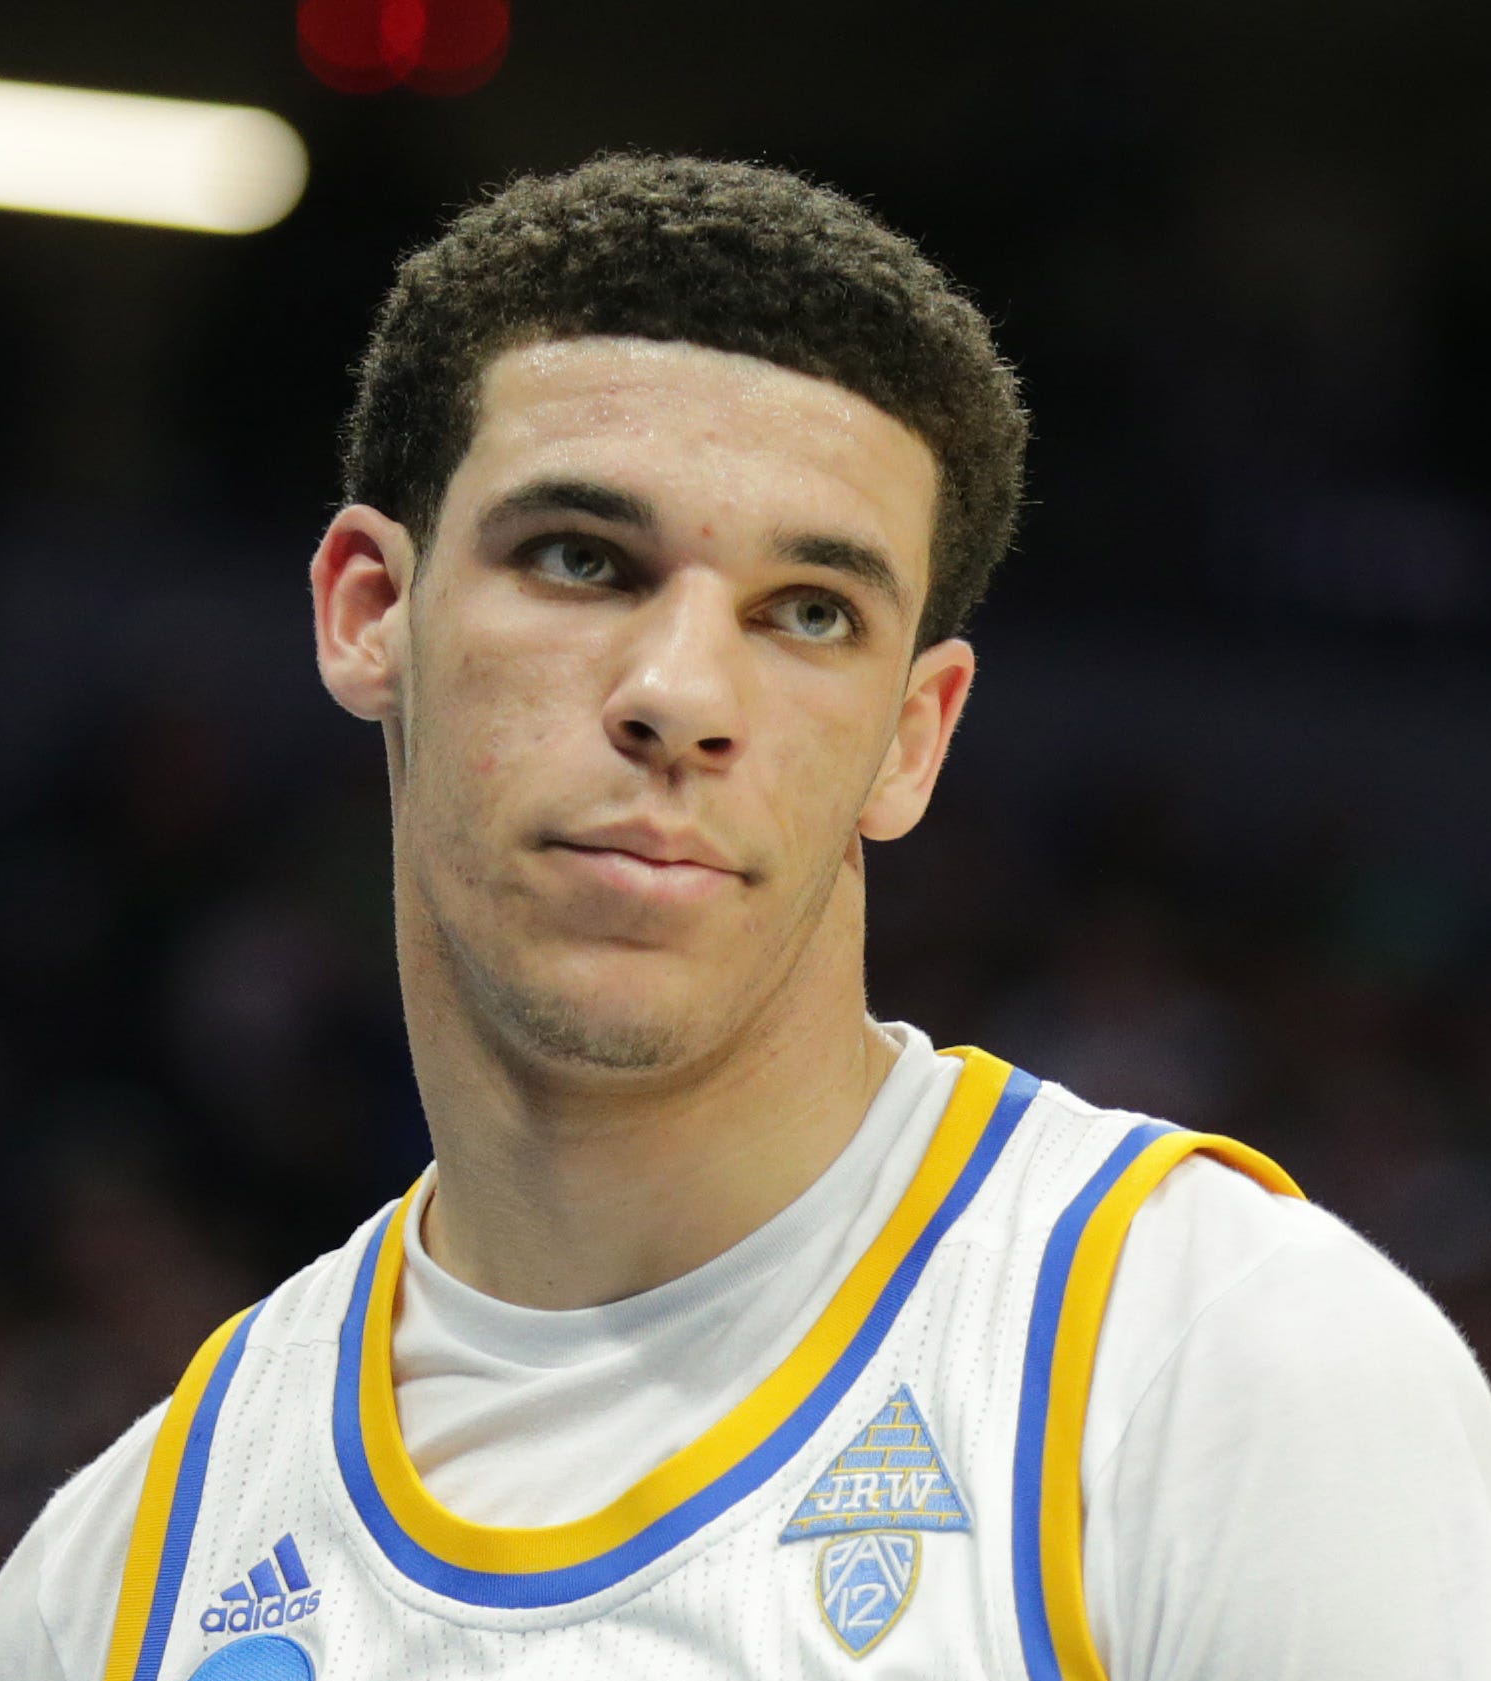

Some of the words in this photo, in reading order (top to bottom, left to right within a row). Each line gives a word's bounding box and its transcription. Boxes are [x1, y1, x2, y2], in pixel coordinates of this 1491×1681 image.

[816, 1472, 942, 1512] JRW
[822, 1534, 911, 1609] PAC
[199, 1588, 322, 1633] adidas
[836, 1582, 887, 1633] 12
